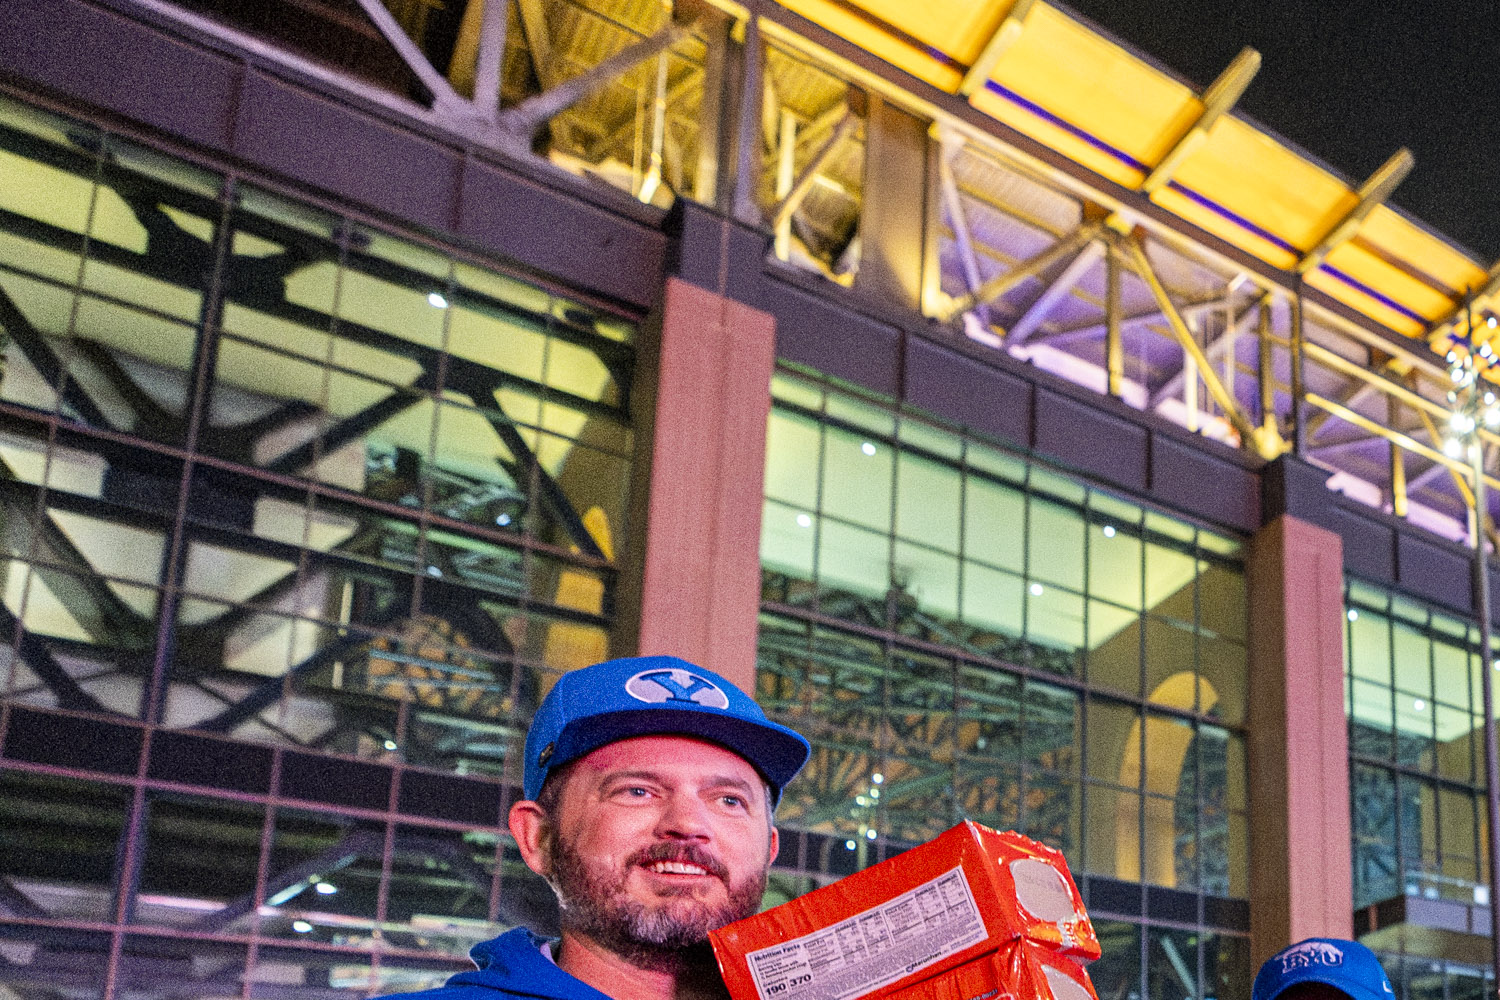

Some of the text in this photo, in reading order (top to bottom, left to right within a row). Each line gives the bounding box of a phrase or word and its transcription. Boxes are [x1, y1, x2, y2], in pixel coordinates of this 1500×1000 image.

[638, 671, 717, 704] Y
[911, 950, 942, 968] Maruchan
[1282, 948, 1344, 974] BYU
[764, 973, 812, 996] 190 370
